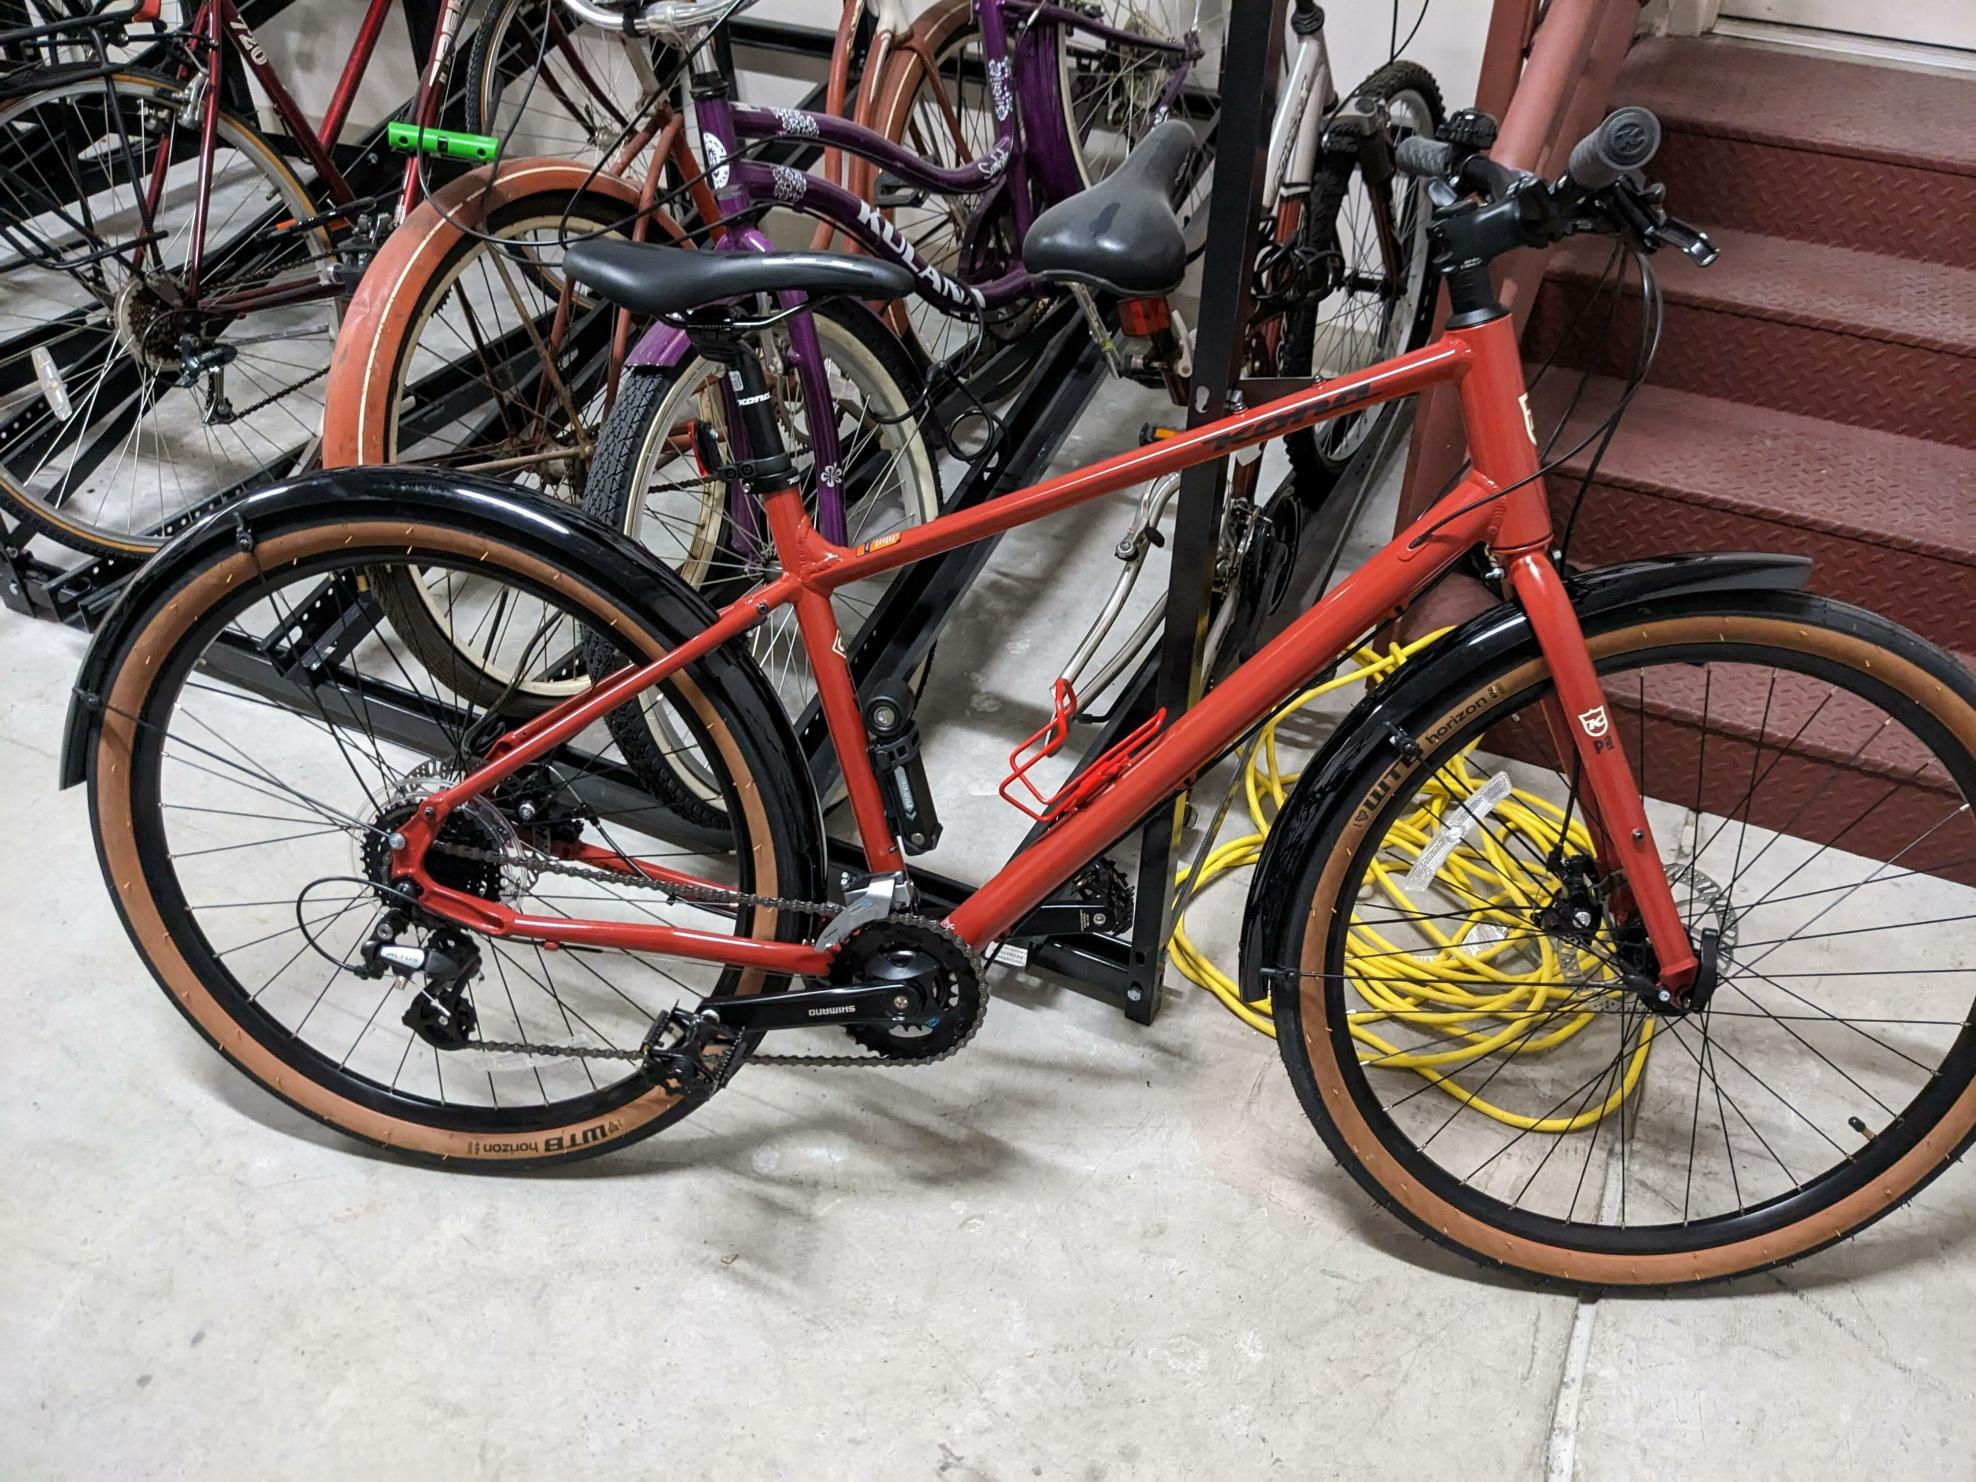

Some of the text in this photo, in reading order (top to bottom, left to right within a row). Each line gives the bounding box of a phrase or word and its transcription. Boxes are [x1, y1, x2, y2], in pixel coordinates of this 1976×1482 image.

[230, 14, 268, 66] 720
[428, 0, 464, 87] RE
[857, 199, 986, 309] KULANA
[1425, 695, 1488, 745] horizon
[808, 1005, 857, 1017] SHIMANO
[483, 1141, 539, 1154] horizon
[544, 1124, 607, 1153] WTB
